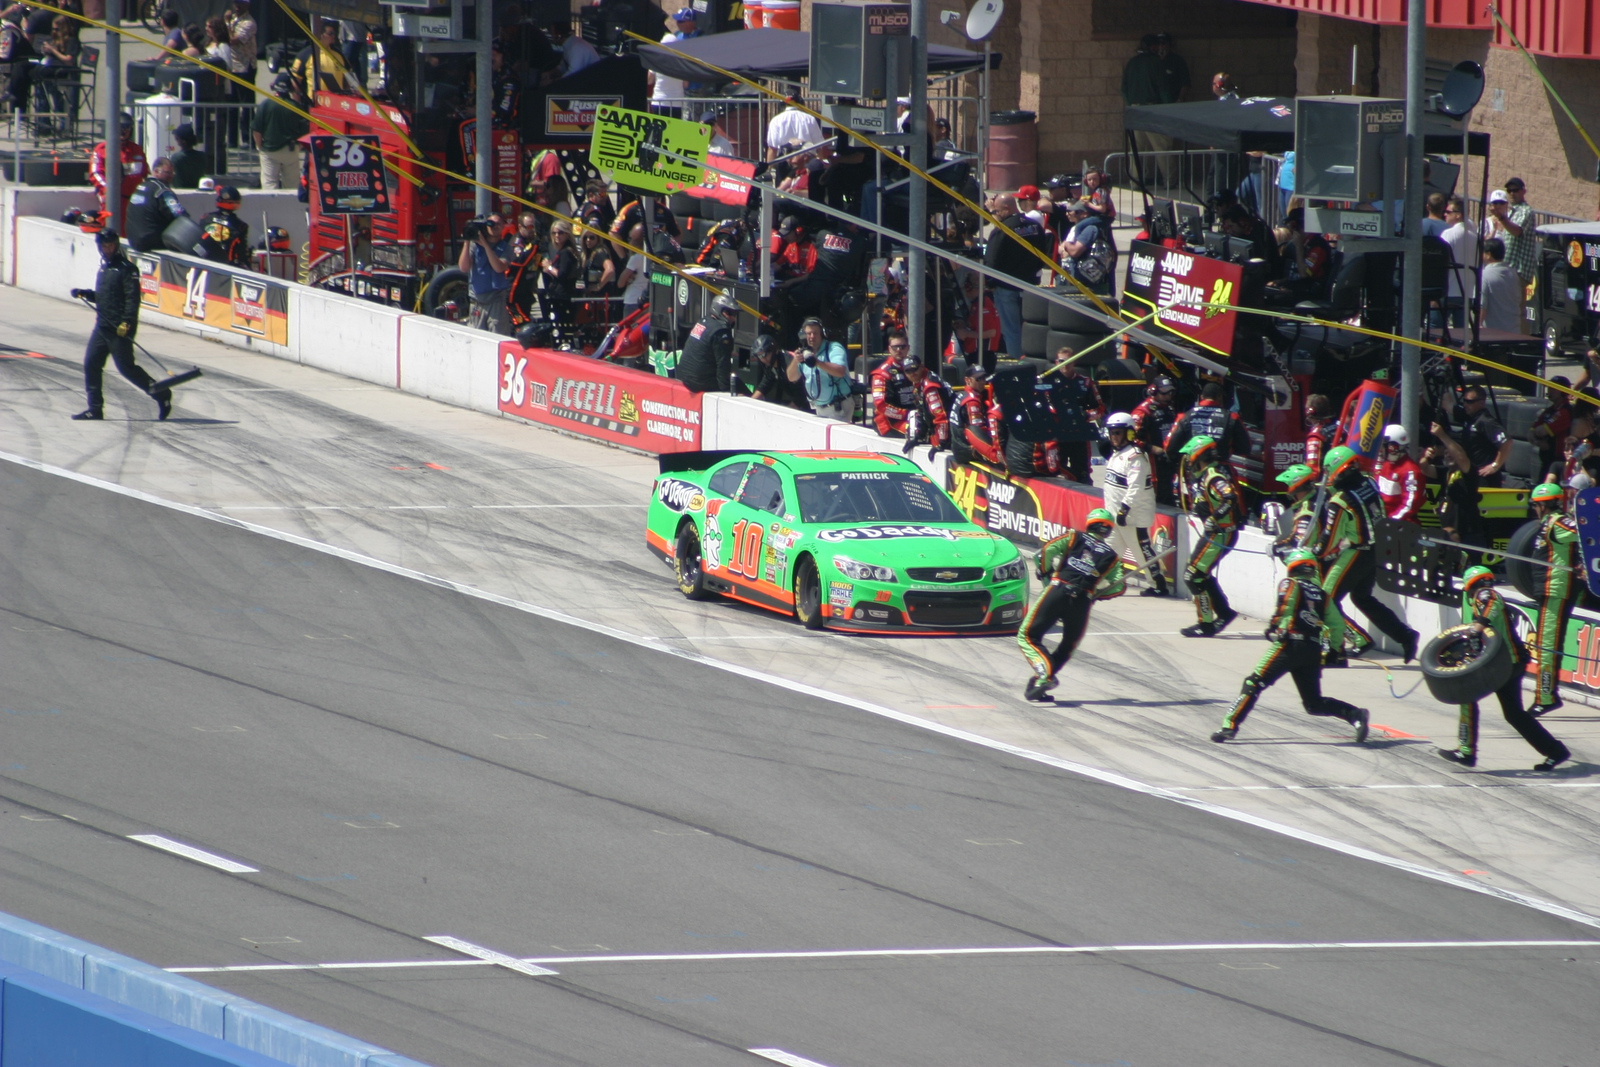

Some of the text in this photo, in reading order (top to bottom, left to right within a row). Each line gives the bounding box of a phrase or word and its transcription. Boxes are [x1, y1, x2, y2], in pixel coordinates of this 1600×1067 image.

[554, 113, 597, 123] TRUCK CEN
[598, 110, 667, 133] AARP
[329, 138, 365, 167] 36
[336, 172, 368, 187] TBR
[598, 157, 697, 184] TO END UNGER
[1161, 252, 1193, 276] AARP
[183, 267, 208, 321] 14
[1158, 275, 1204, 310] DRIVE
[1206, 278, 1233, 318] 24
[1165, 310, 1178, 322] END
[1177, 313, 1201, 327] HUNGER
[500, 353, 527, 406] 36
[530, 381, 547, 406] TBR
[551, 377, 616, 416] ACCELL
[641, 399, 700, 425] CONSTRUCTION, INC
[1359, 397, 1384, 452] SUNOCO
[646, 419, 694, 442] CLAREMORE, OK
[1271, 442, 1305, 451] AARP
[1273, 452, 1304, 464] DRI
[841, 472, 890, 480] PATRICK
[952, 467, 978, 520] 24
[987, 482, 1016, 505] AARP
[988, 502, 1026, 533] DRIVE
[1026, 516, 1041, 537] TO
[728, 518, 764, 582] 10
[830, 581, 853, 590] MOOG
[874, 590, 892, 603] 10
[1572, 623, 1600, 690] 10
